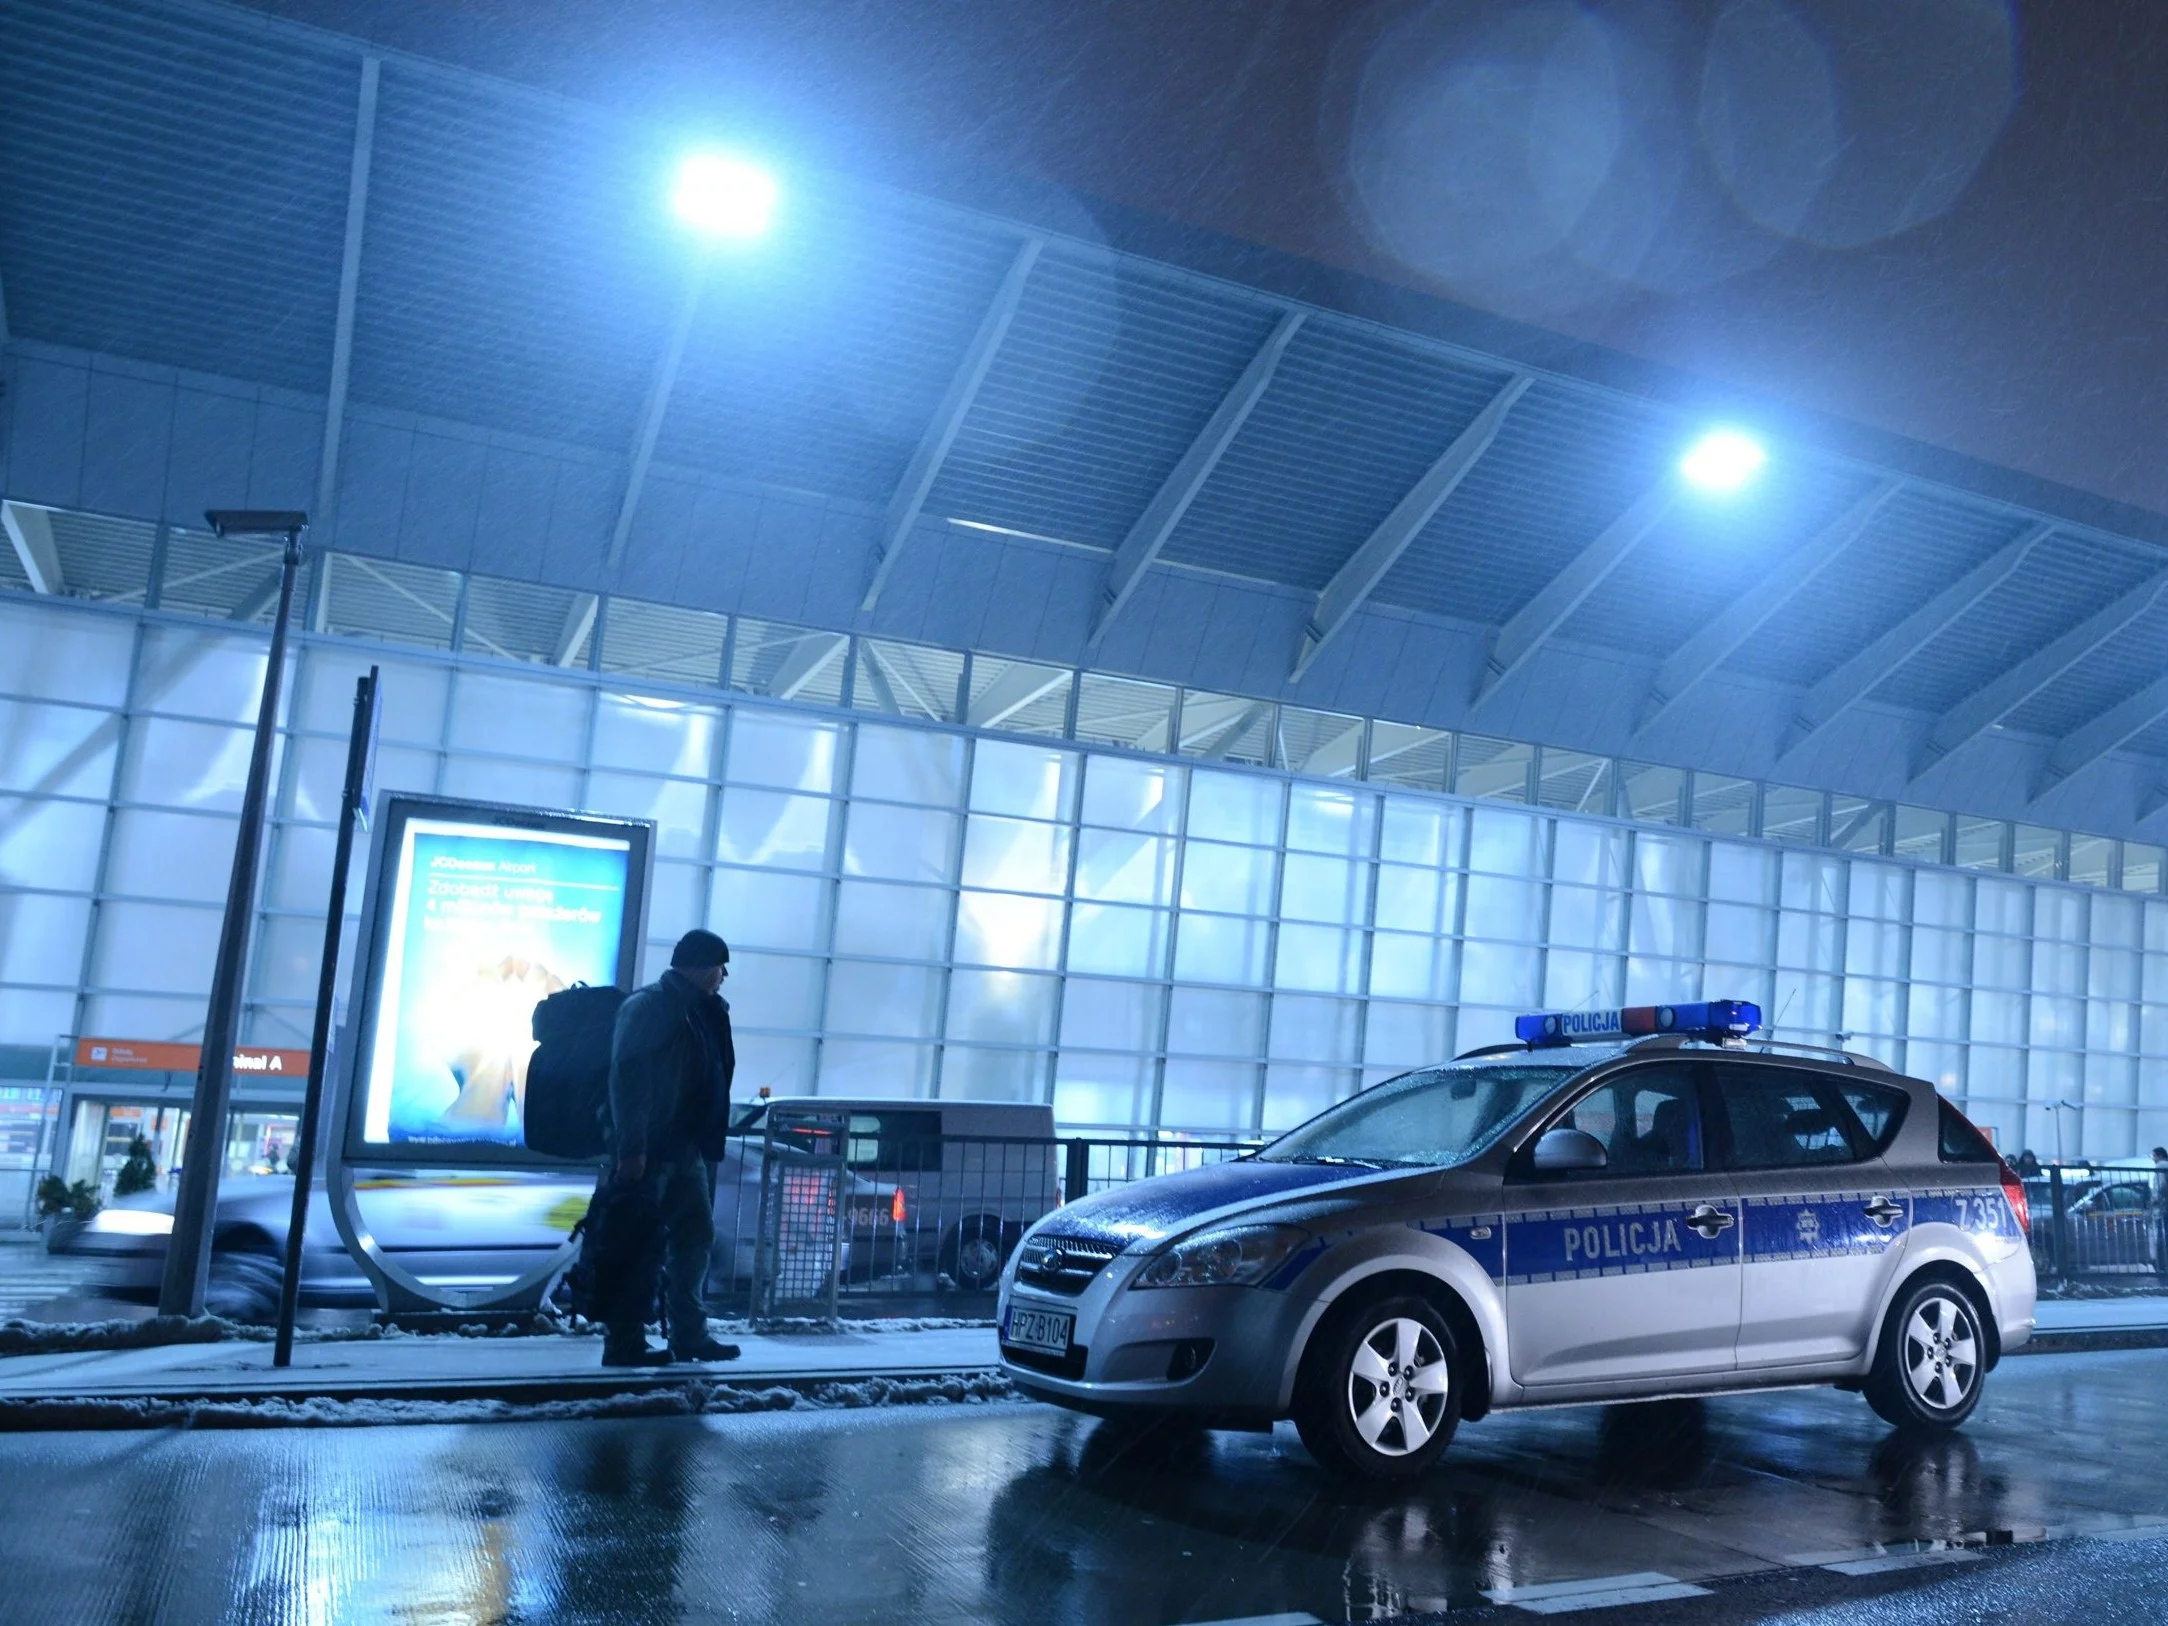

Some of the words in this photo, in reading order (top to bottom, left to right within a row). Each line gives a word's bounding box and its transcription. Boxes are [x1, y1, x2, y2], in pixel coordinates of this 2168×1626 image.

[1562, 1013, 1620, 1035] POLICJA
[269, 1055, 282, 1071] A
[1973, 1197, 2007, 1232] 351
[1563, 1218, 1682, 1262] POLICJA
